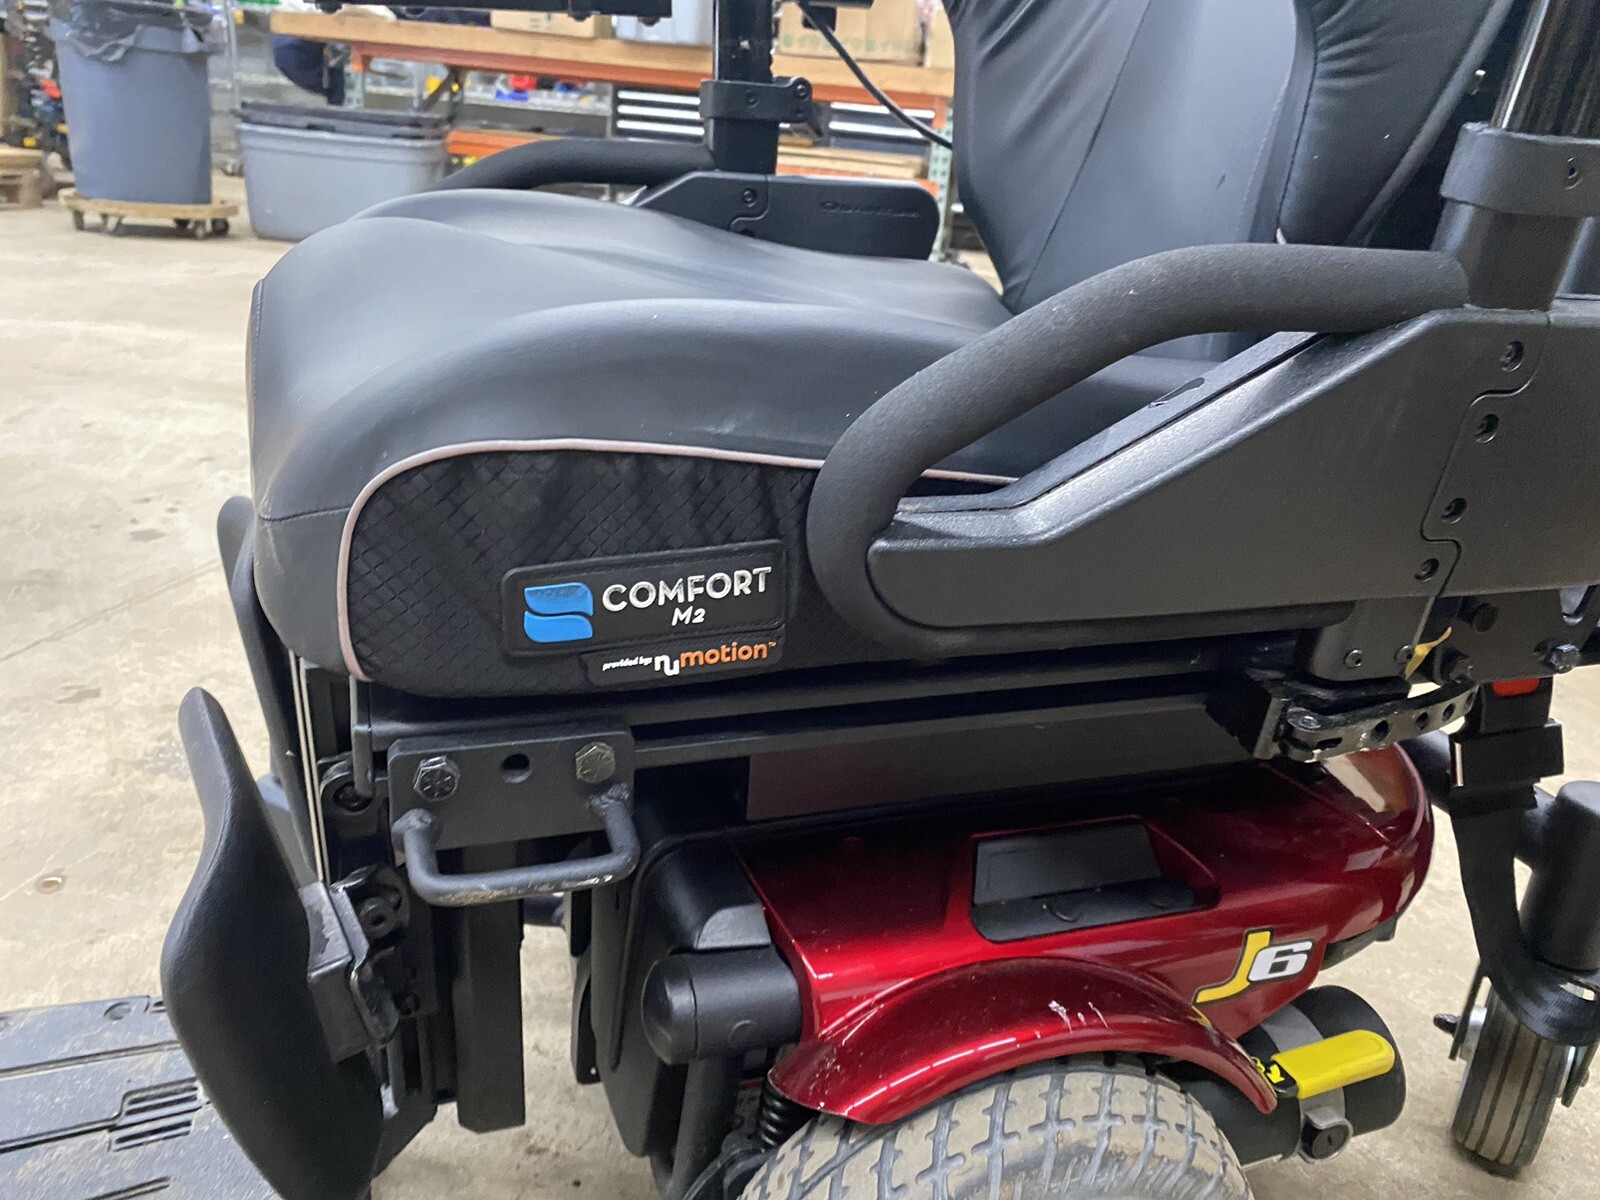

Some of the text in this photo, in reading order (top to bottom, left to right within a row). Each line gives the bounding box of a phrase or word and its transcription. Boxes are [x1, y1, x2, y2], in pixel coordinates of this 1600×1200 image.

[602, 566, 772, 612] COMFORT
[671, 605, 706, 627] M2
[602, 656, 639, 671] provided
[1196, 930, 1313, 1004] J6
